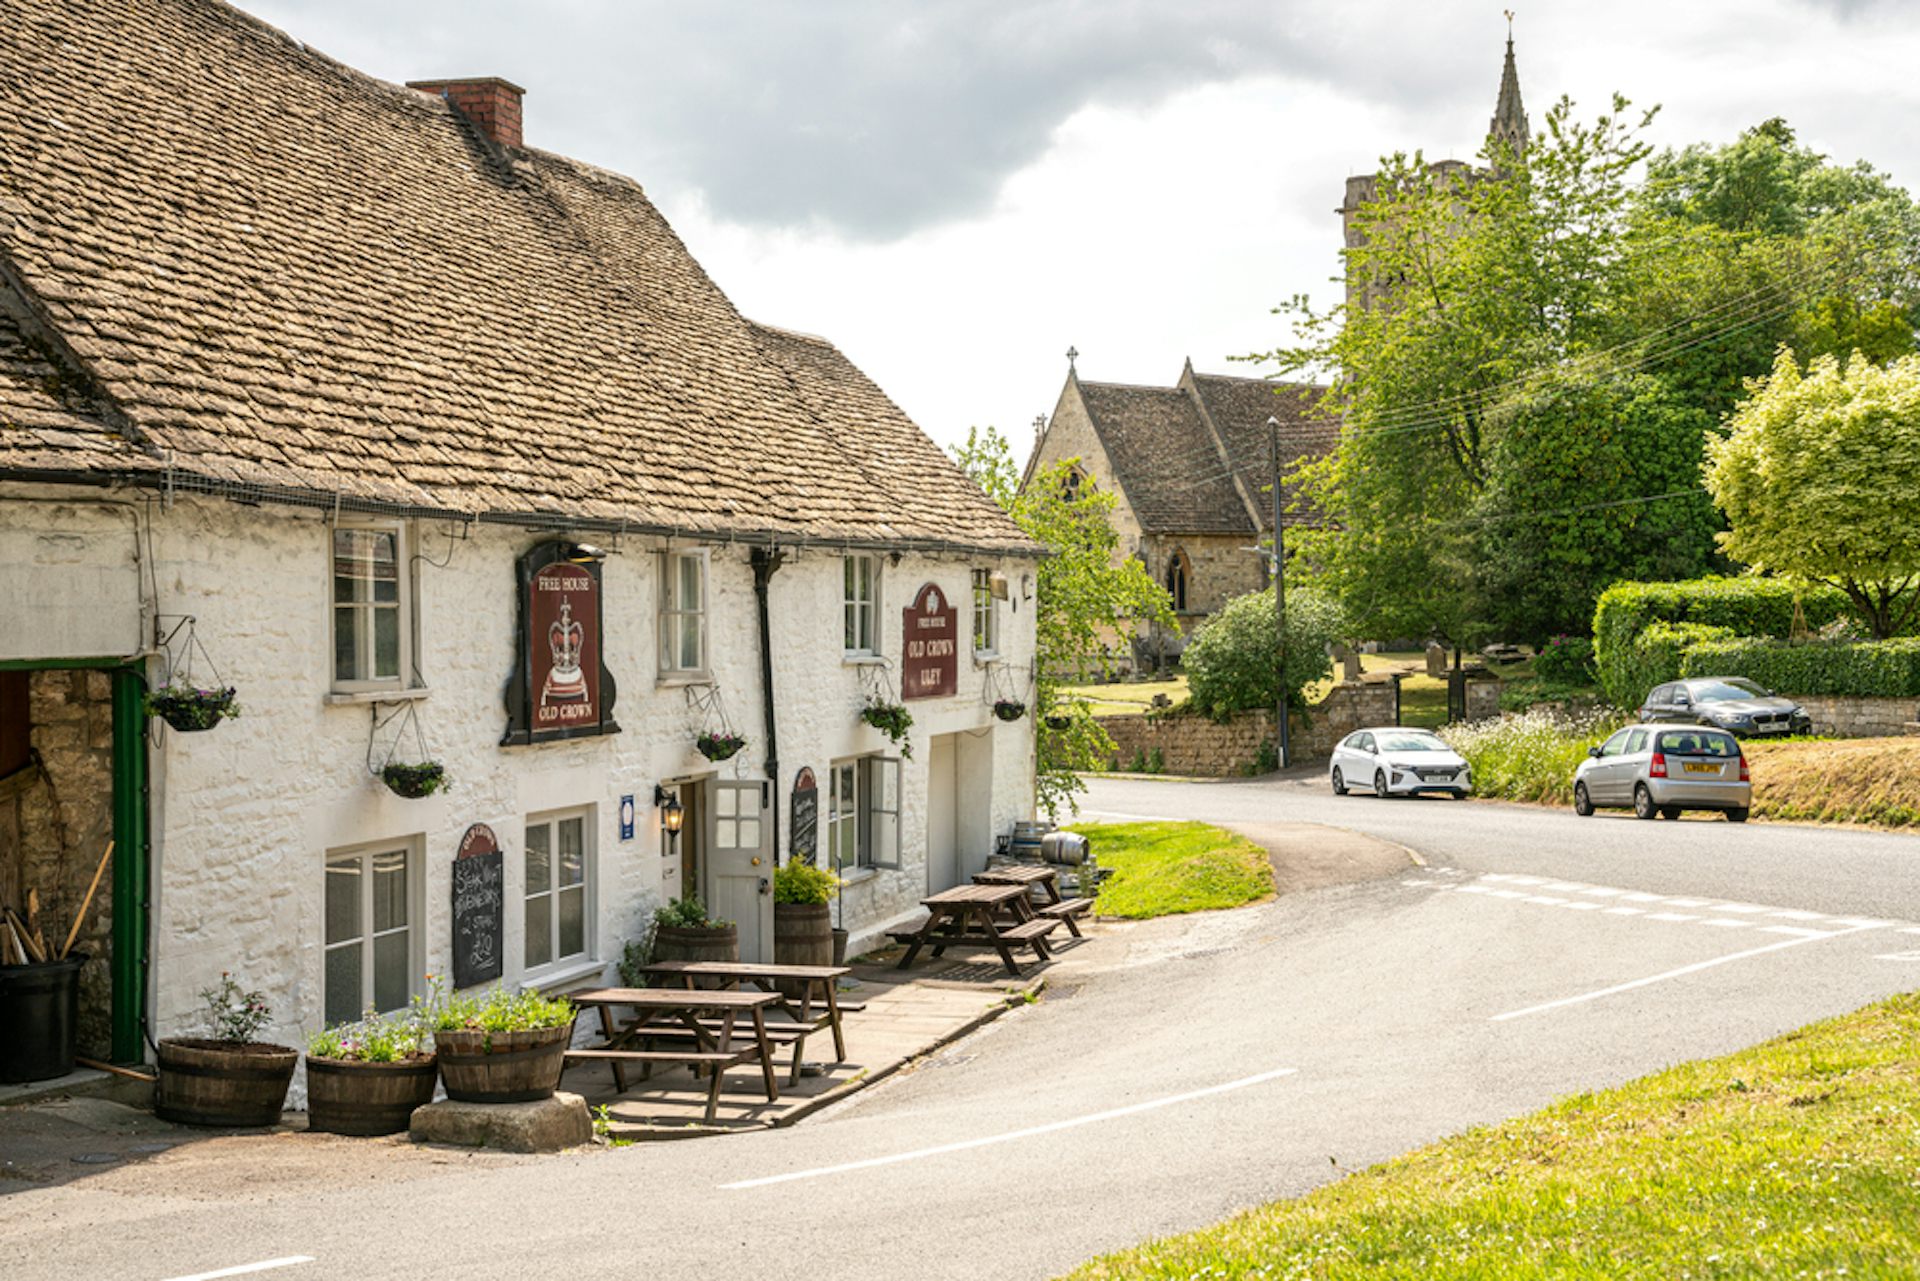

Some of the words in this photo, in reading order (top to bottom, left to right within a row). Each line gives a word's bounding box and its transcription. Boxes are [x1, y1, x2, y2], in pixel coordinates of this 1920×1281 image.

[539, 576, 561, 591] FREE
[562, 577, 590, 591] HOUSE
[907, 640, 926, 658] OLD
[926, 638, 954, 656] CROWN
[920, 667, 942, 687] ULEY
[539, 705, 559, 721] OLD
[560, 703, 593, 719] CROWN
